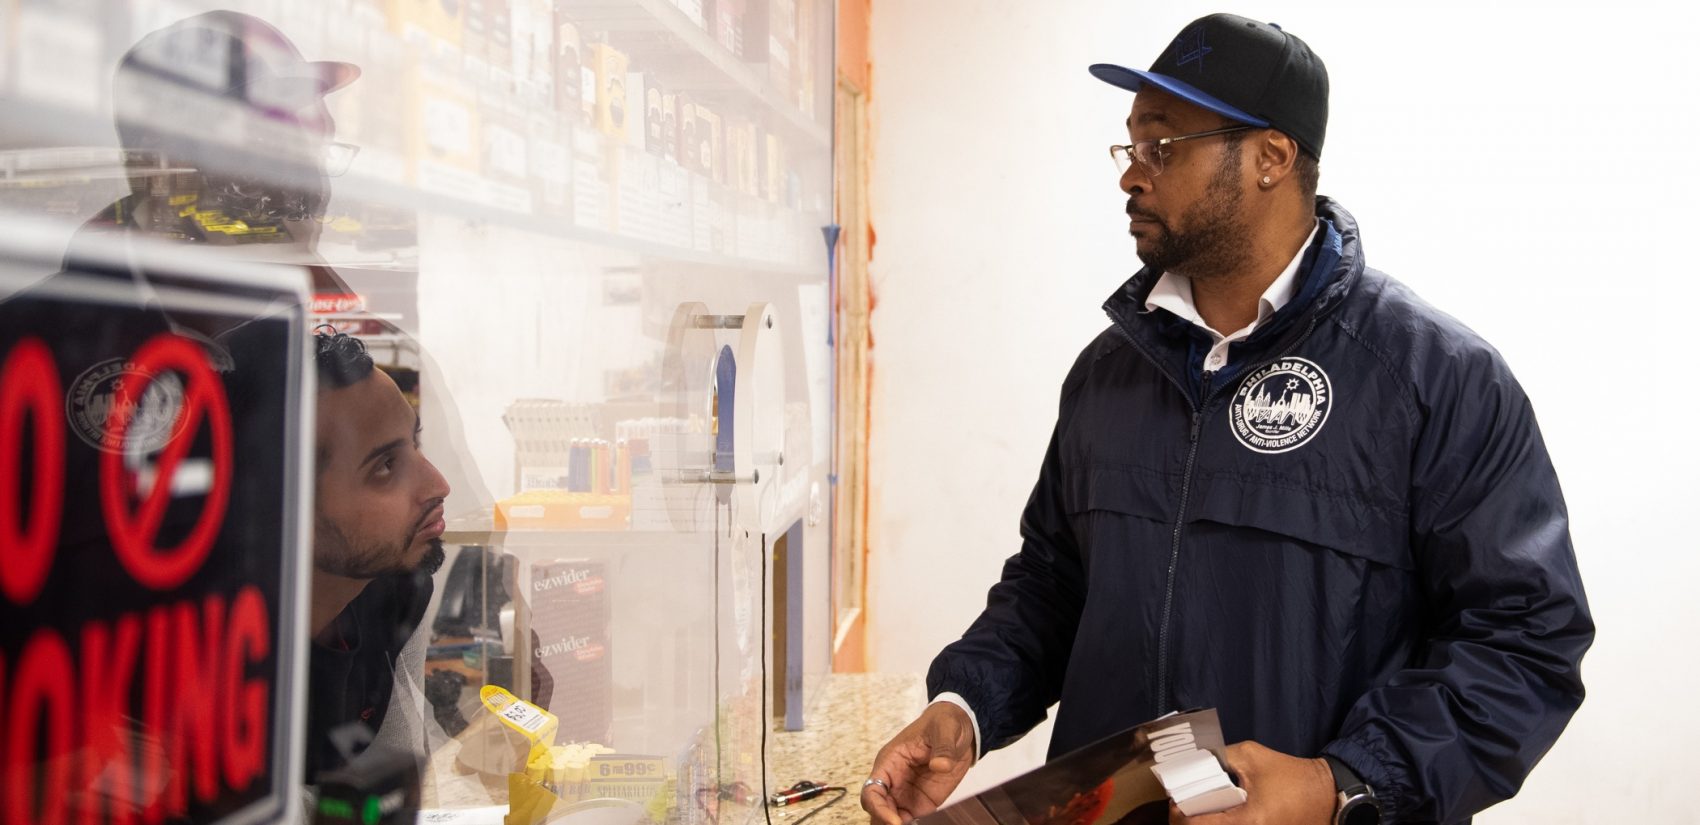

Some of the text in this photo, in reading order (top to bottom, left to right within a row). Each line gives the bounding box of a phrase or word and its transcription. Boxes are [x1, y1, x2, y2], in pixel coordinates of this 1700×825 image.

[1240, 362, 1326, 406] PHILADELPHIA
[1249, 434, 1298, 448] ANTI-VIOLENCE
[1297, 409, 1322, 440] NETWORK
[0, 585, 270, 825] OKING
[1147, 722, 1198, 763] YOU
[599, 763, 611, 776] 6
